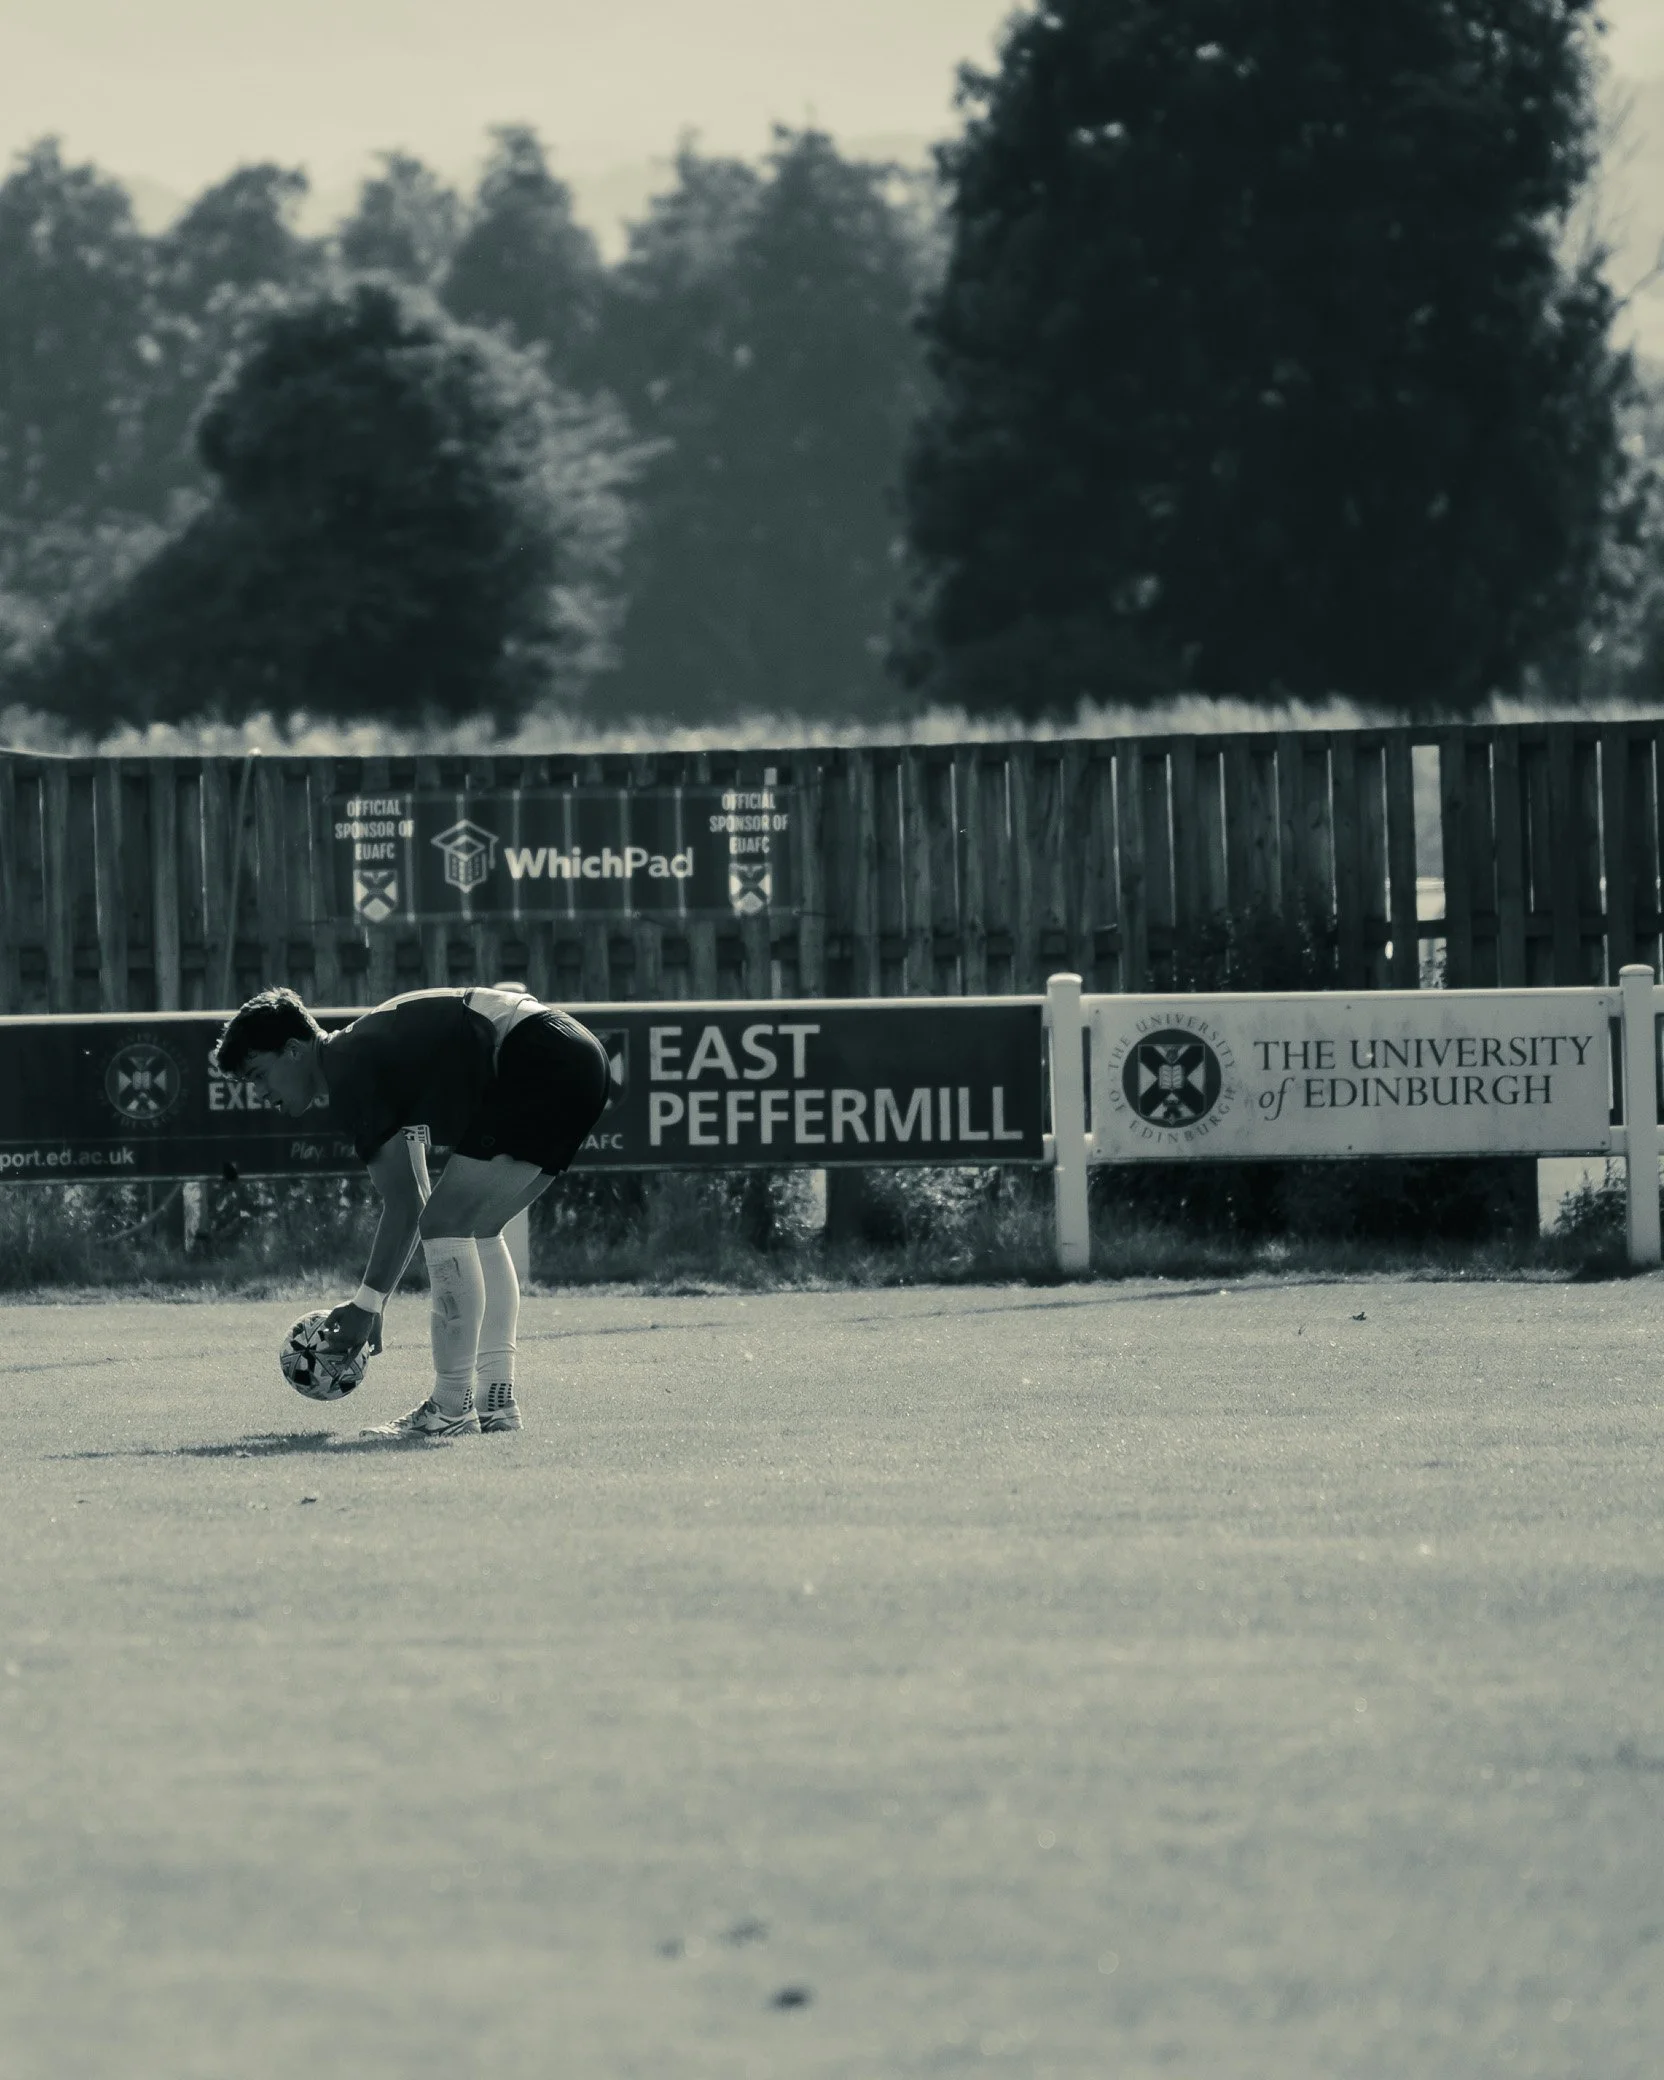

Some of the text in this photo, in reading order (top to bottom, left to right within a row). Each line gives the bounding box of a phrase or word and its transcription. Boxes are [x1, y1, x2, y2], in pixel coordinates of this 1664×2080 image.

[346, 800, 402, 818] OFFICIAL
[722, 792, 777, 811] OFFICIAL
[334, 820, 414, 839] SPONSOR OF
[709, 815, 788, 833] SPONSOR OF
[355, 843, 395, 861] EUAFC
[729, 838, 770, 855] EUAFC
[504, 847, 694, 880] WhichPad
[649, 1023, 821, 1081] EAST
[1253, 1035, 1594, 1072] THE UNIVERSITY
[1257, 1074, 1552, 1121] of EDINBURGH
[649, 1085, 1023, 1147] PEFFERMILL
[578, 1133, 624, 1151] AFC
